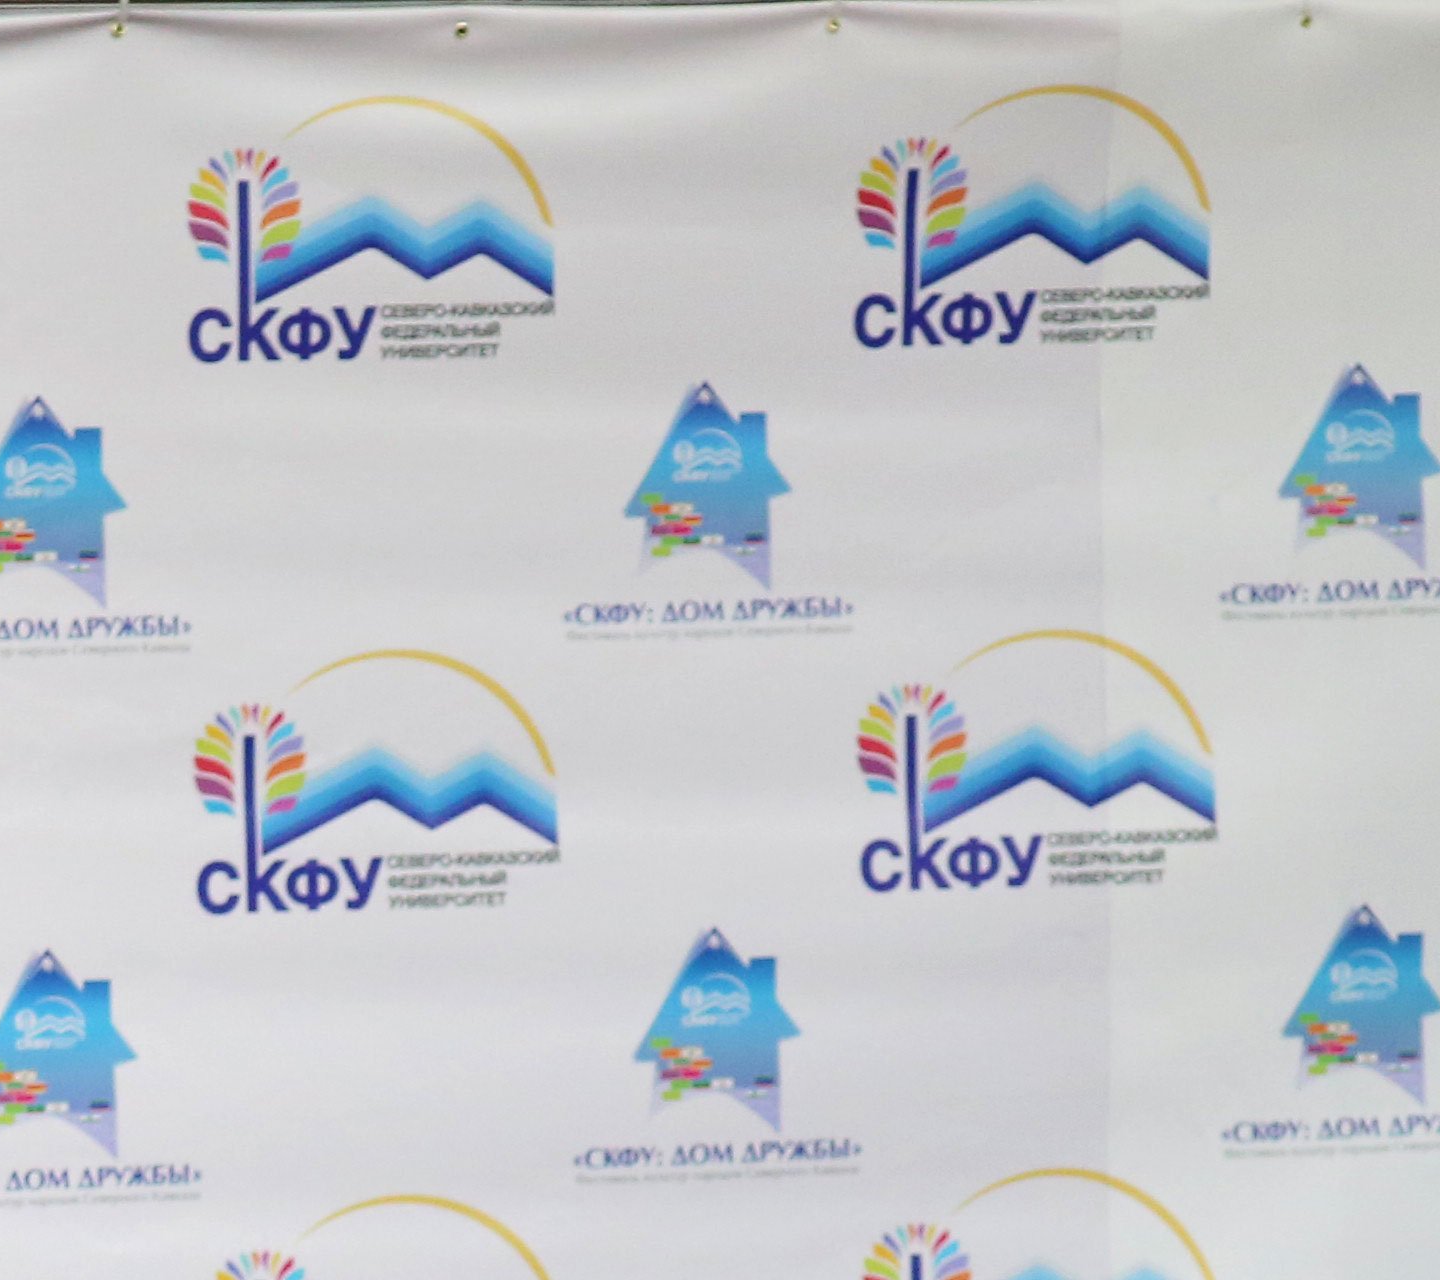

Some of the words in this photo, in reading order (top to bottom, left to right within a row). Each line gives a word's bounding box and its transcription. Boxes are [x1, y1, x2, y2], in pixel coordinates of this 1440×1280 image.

[853, 291, 1037, 350] СКФУ
[188, 306, 376, 365] СКФУ
[1314, 579, 1381, 605] ДОМ
[660, 599, 726, 625] ДОМ
[859, 835, 1043, 894] СКФУ
[195, 857, 384, 917] СКФУ
[1317, 1116, 1381, 1142] ДОМ
[671, 1142, 734, 1167] ДОМ
[4, 1168, 70, 1193] ДОМ
